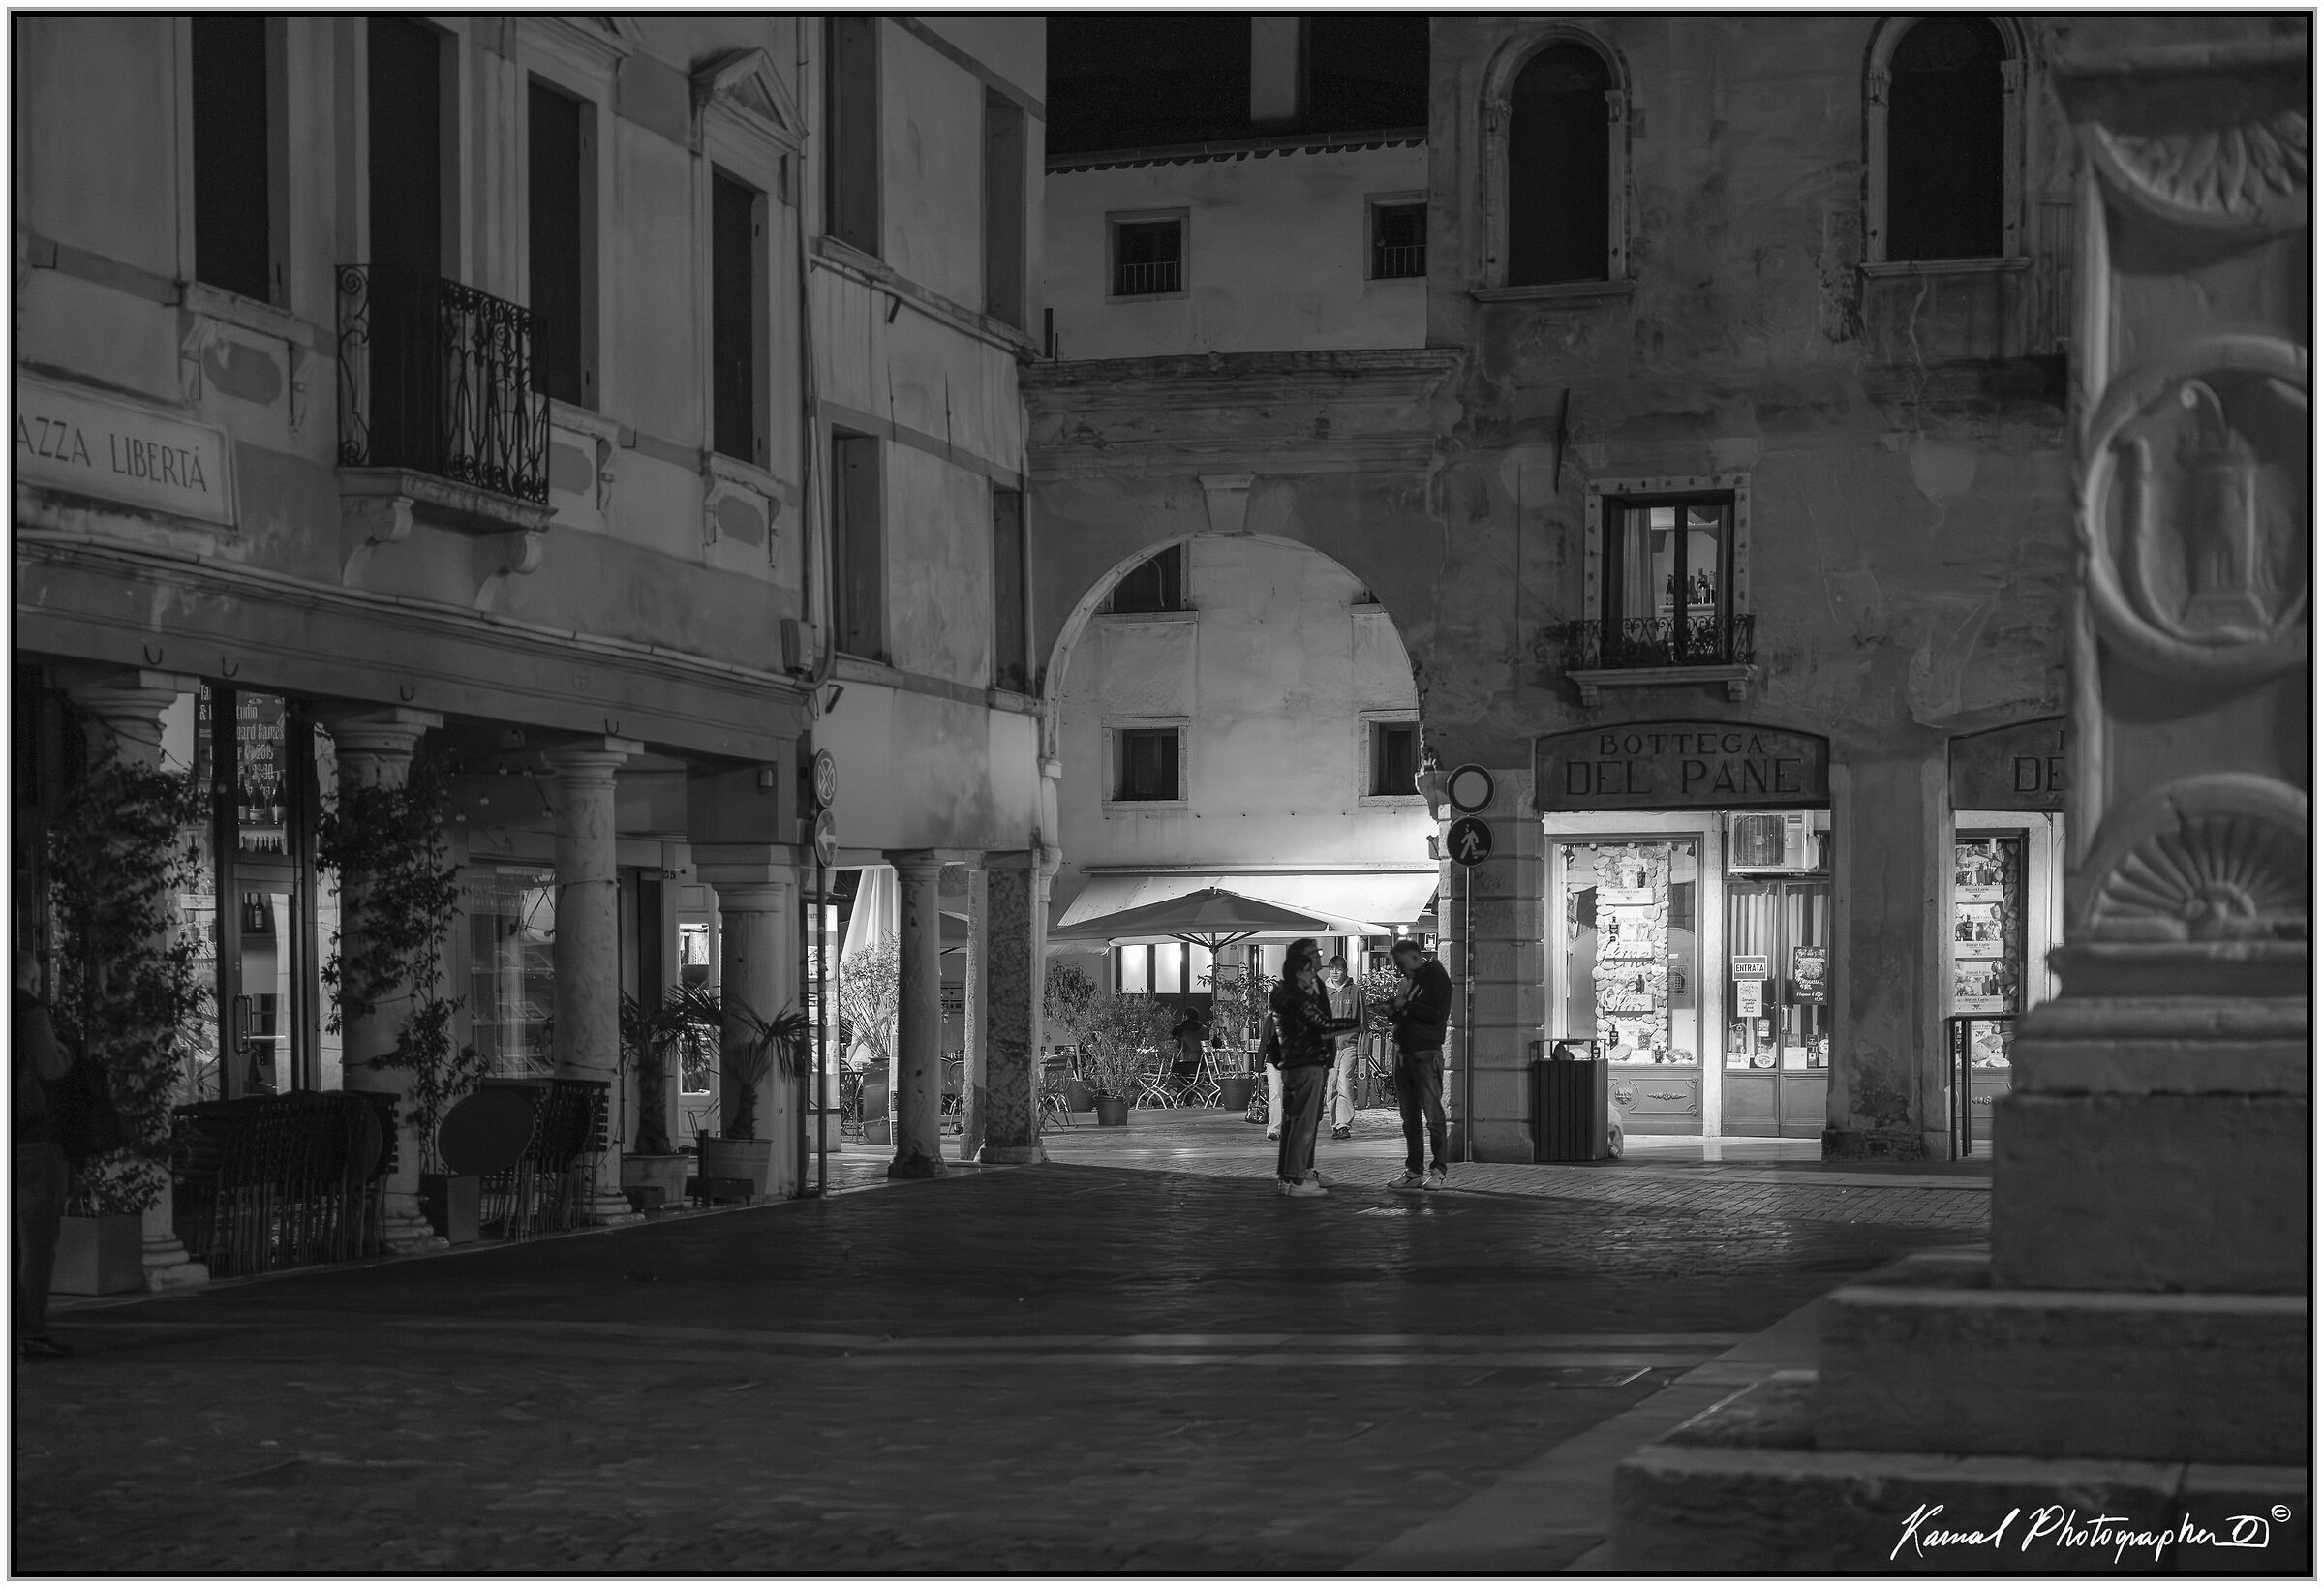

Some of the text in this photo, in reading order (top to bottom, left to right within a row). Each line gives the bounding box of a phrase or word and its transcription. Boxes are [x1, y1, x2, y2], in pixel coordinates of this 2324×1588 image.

[17, 414, 91, 467] AZZA
[236, 703, 258, 720] tudio
[236, 723, 256, 740] oard
[1599, 733, 1764, 755] BOTTEGA
[1565, 758, 1802, 796] DEL PANE
[2013, 756, 2064, 792] DE
[1735, 963, 1764, 972] ENTRATA
